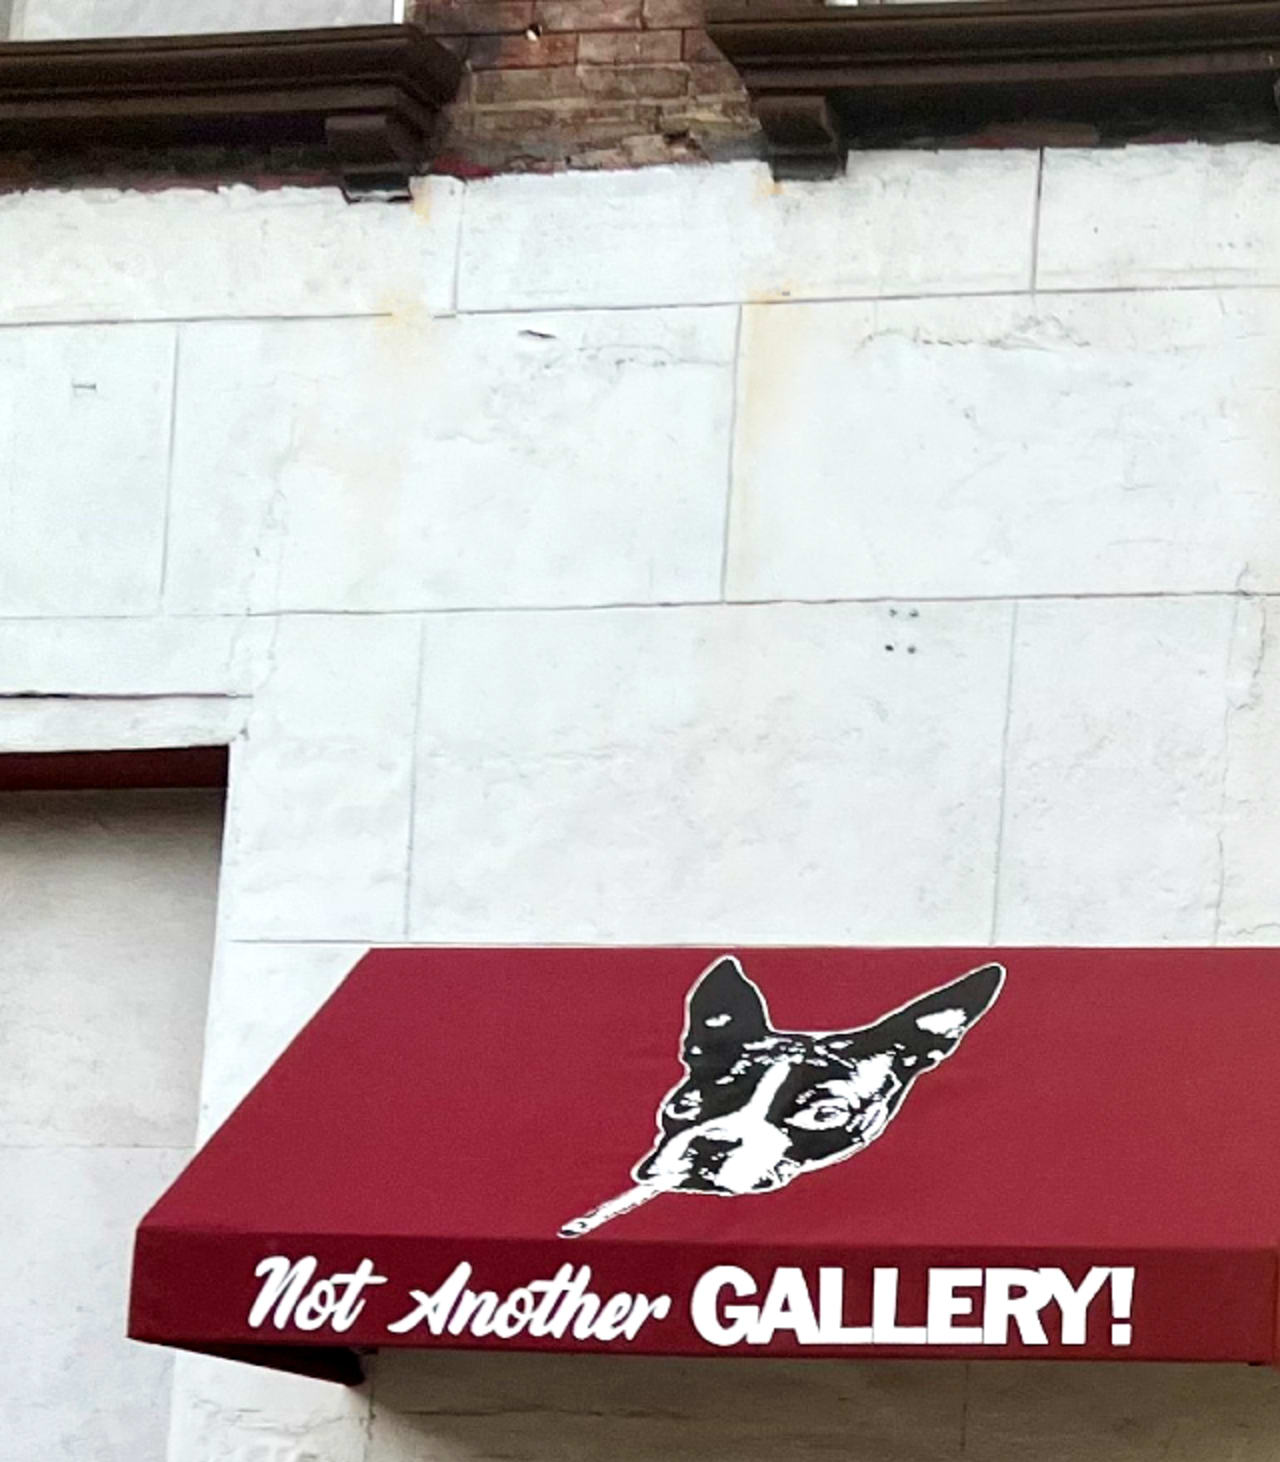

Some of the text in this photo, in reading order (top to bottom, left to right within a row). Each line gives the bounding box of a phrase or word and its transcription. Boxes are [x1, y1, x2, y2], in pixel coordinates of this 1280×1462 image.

[248, 1255, 1135, 1347] Not Another GALLERY!
